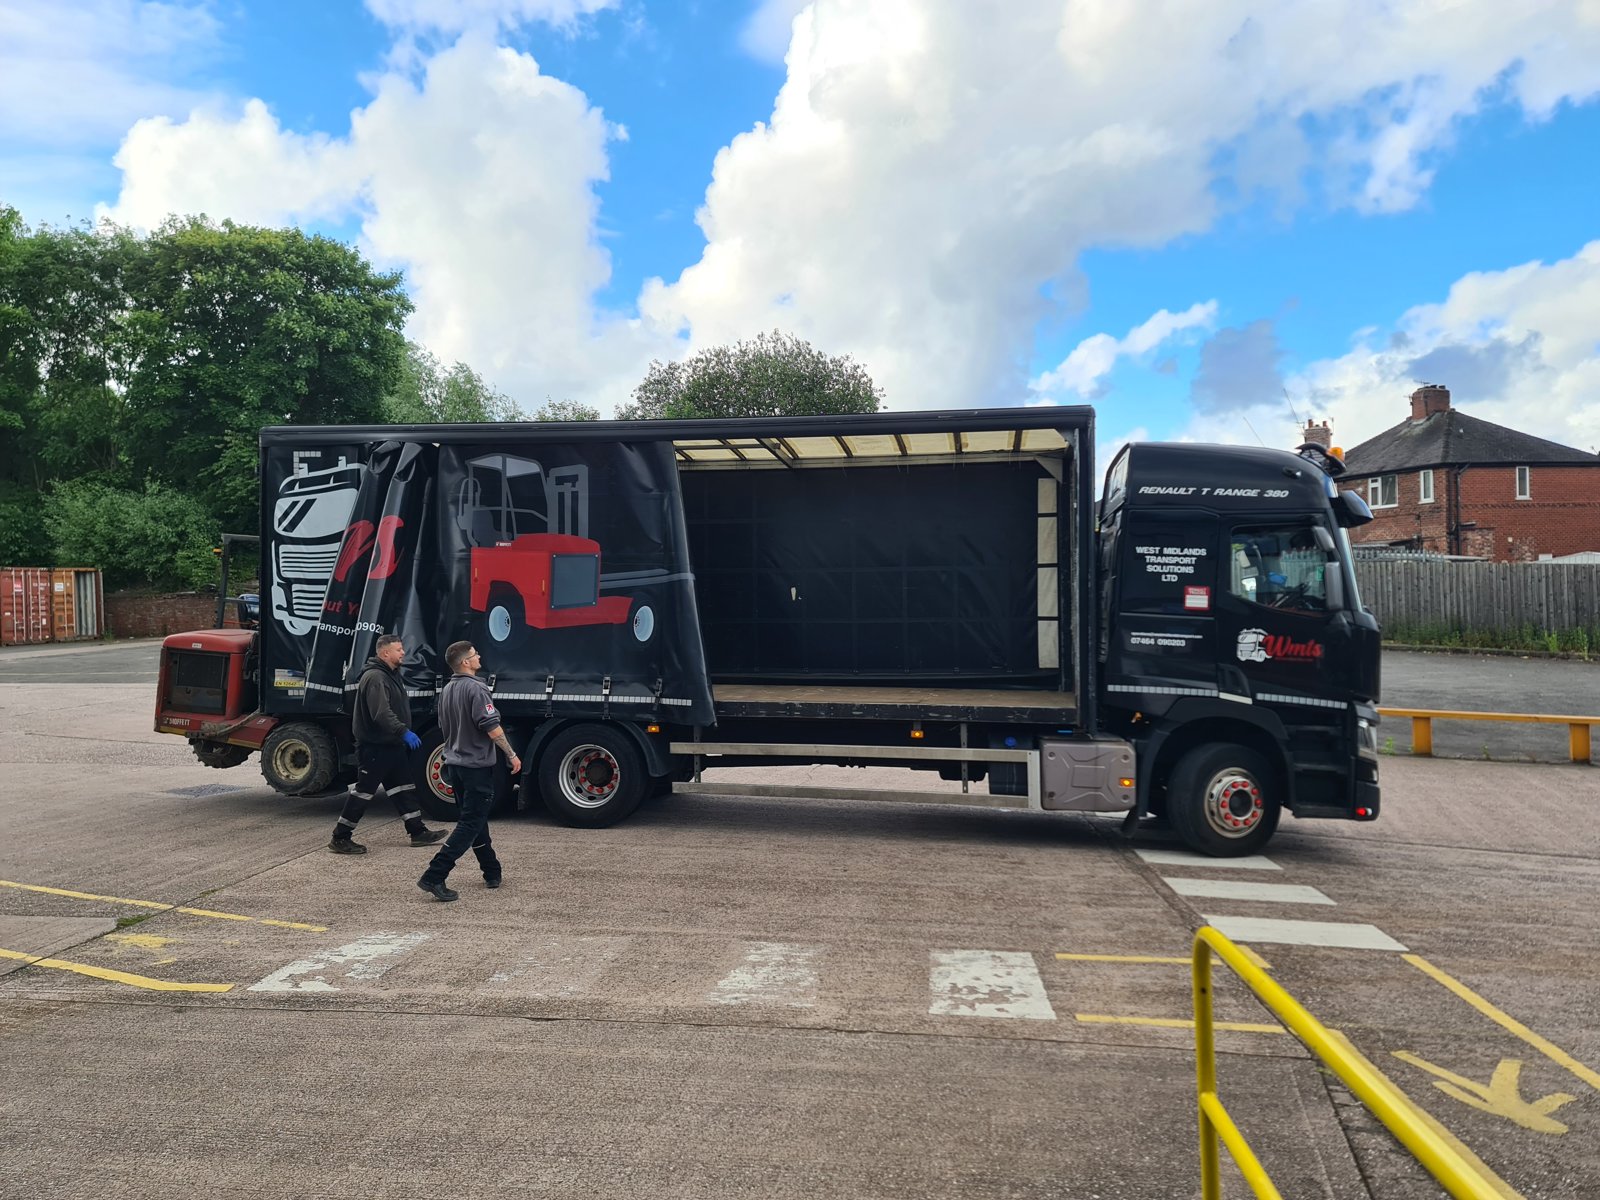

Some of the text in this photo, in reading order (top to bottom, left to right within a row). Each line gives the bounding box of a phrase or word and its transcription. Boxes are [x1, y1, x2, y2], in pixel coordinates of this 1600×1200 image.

[1138, 486, 1289, 498] RENAULT T RANGE 380
[1135, 546, 1207, 556] WEST MIDLANDS
[1145, 555, 1197, 564] TRANSPORT
[1146, 565, 1194, 573] SOLUTIONS
[1161, 574, 1178, 582] LTD
